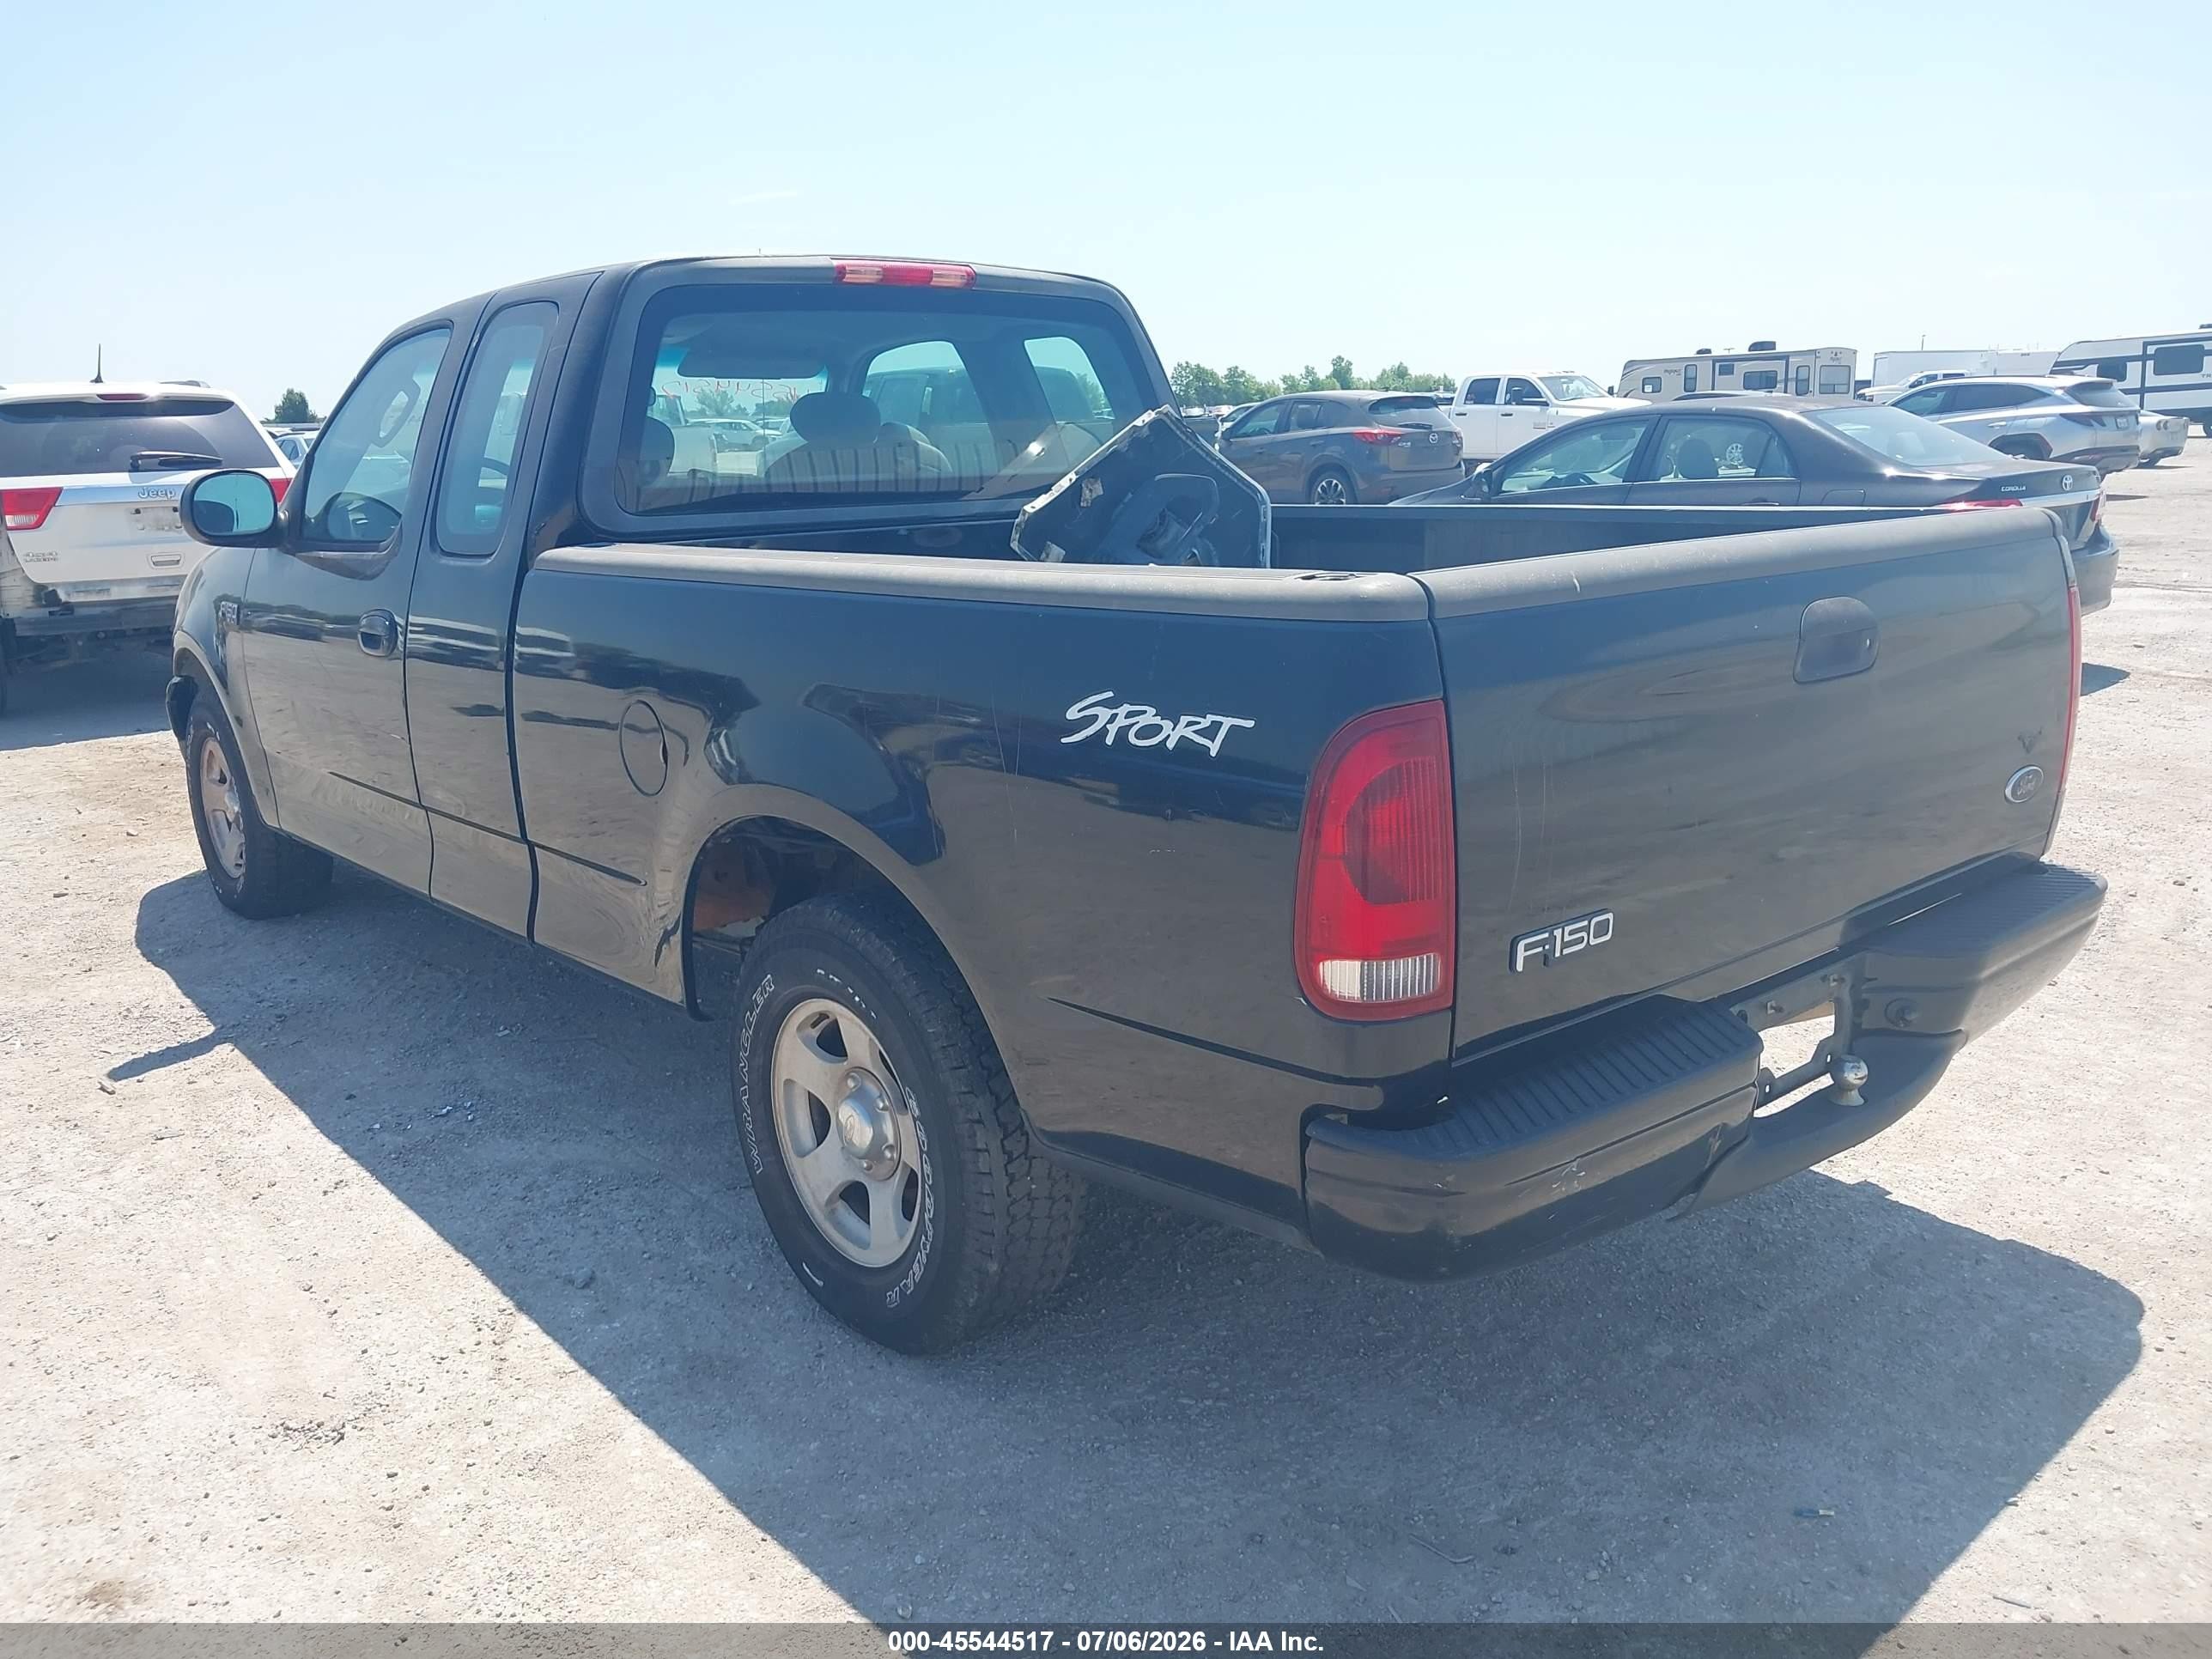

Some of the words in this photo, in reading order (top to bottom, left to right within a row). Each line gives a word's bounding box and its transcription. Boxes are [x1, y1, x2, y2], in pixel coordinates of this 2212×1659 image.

[138, 486, 176, 501] Jeep
[1060, 690, 1256, 758] SPORT
[738, 974, 775, 1175] WRANGLER
[886, 1087, 935, 1309] GOODYEAR
